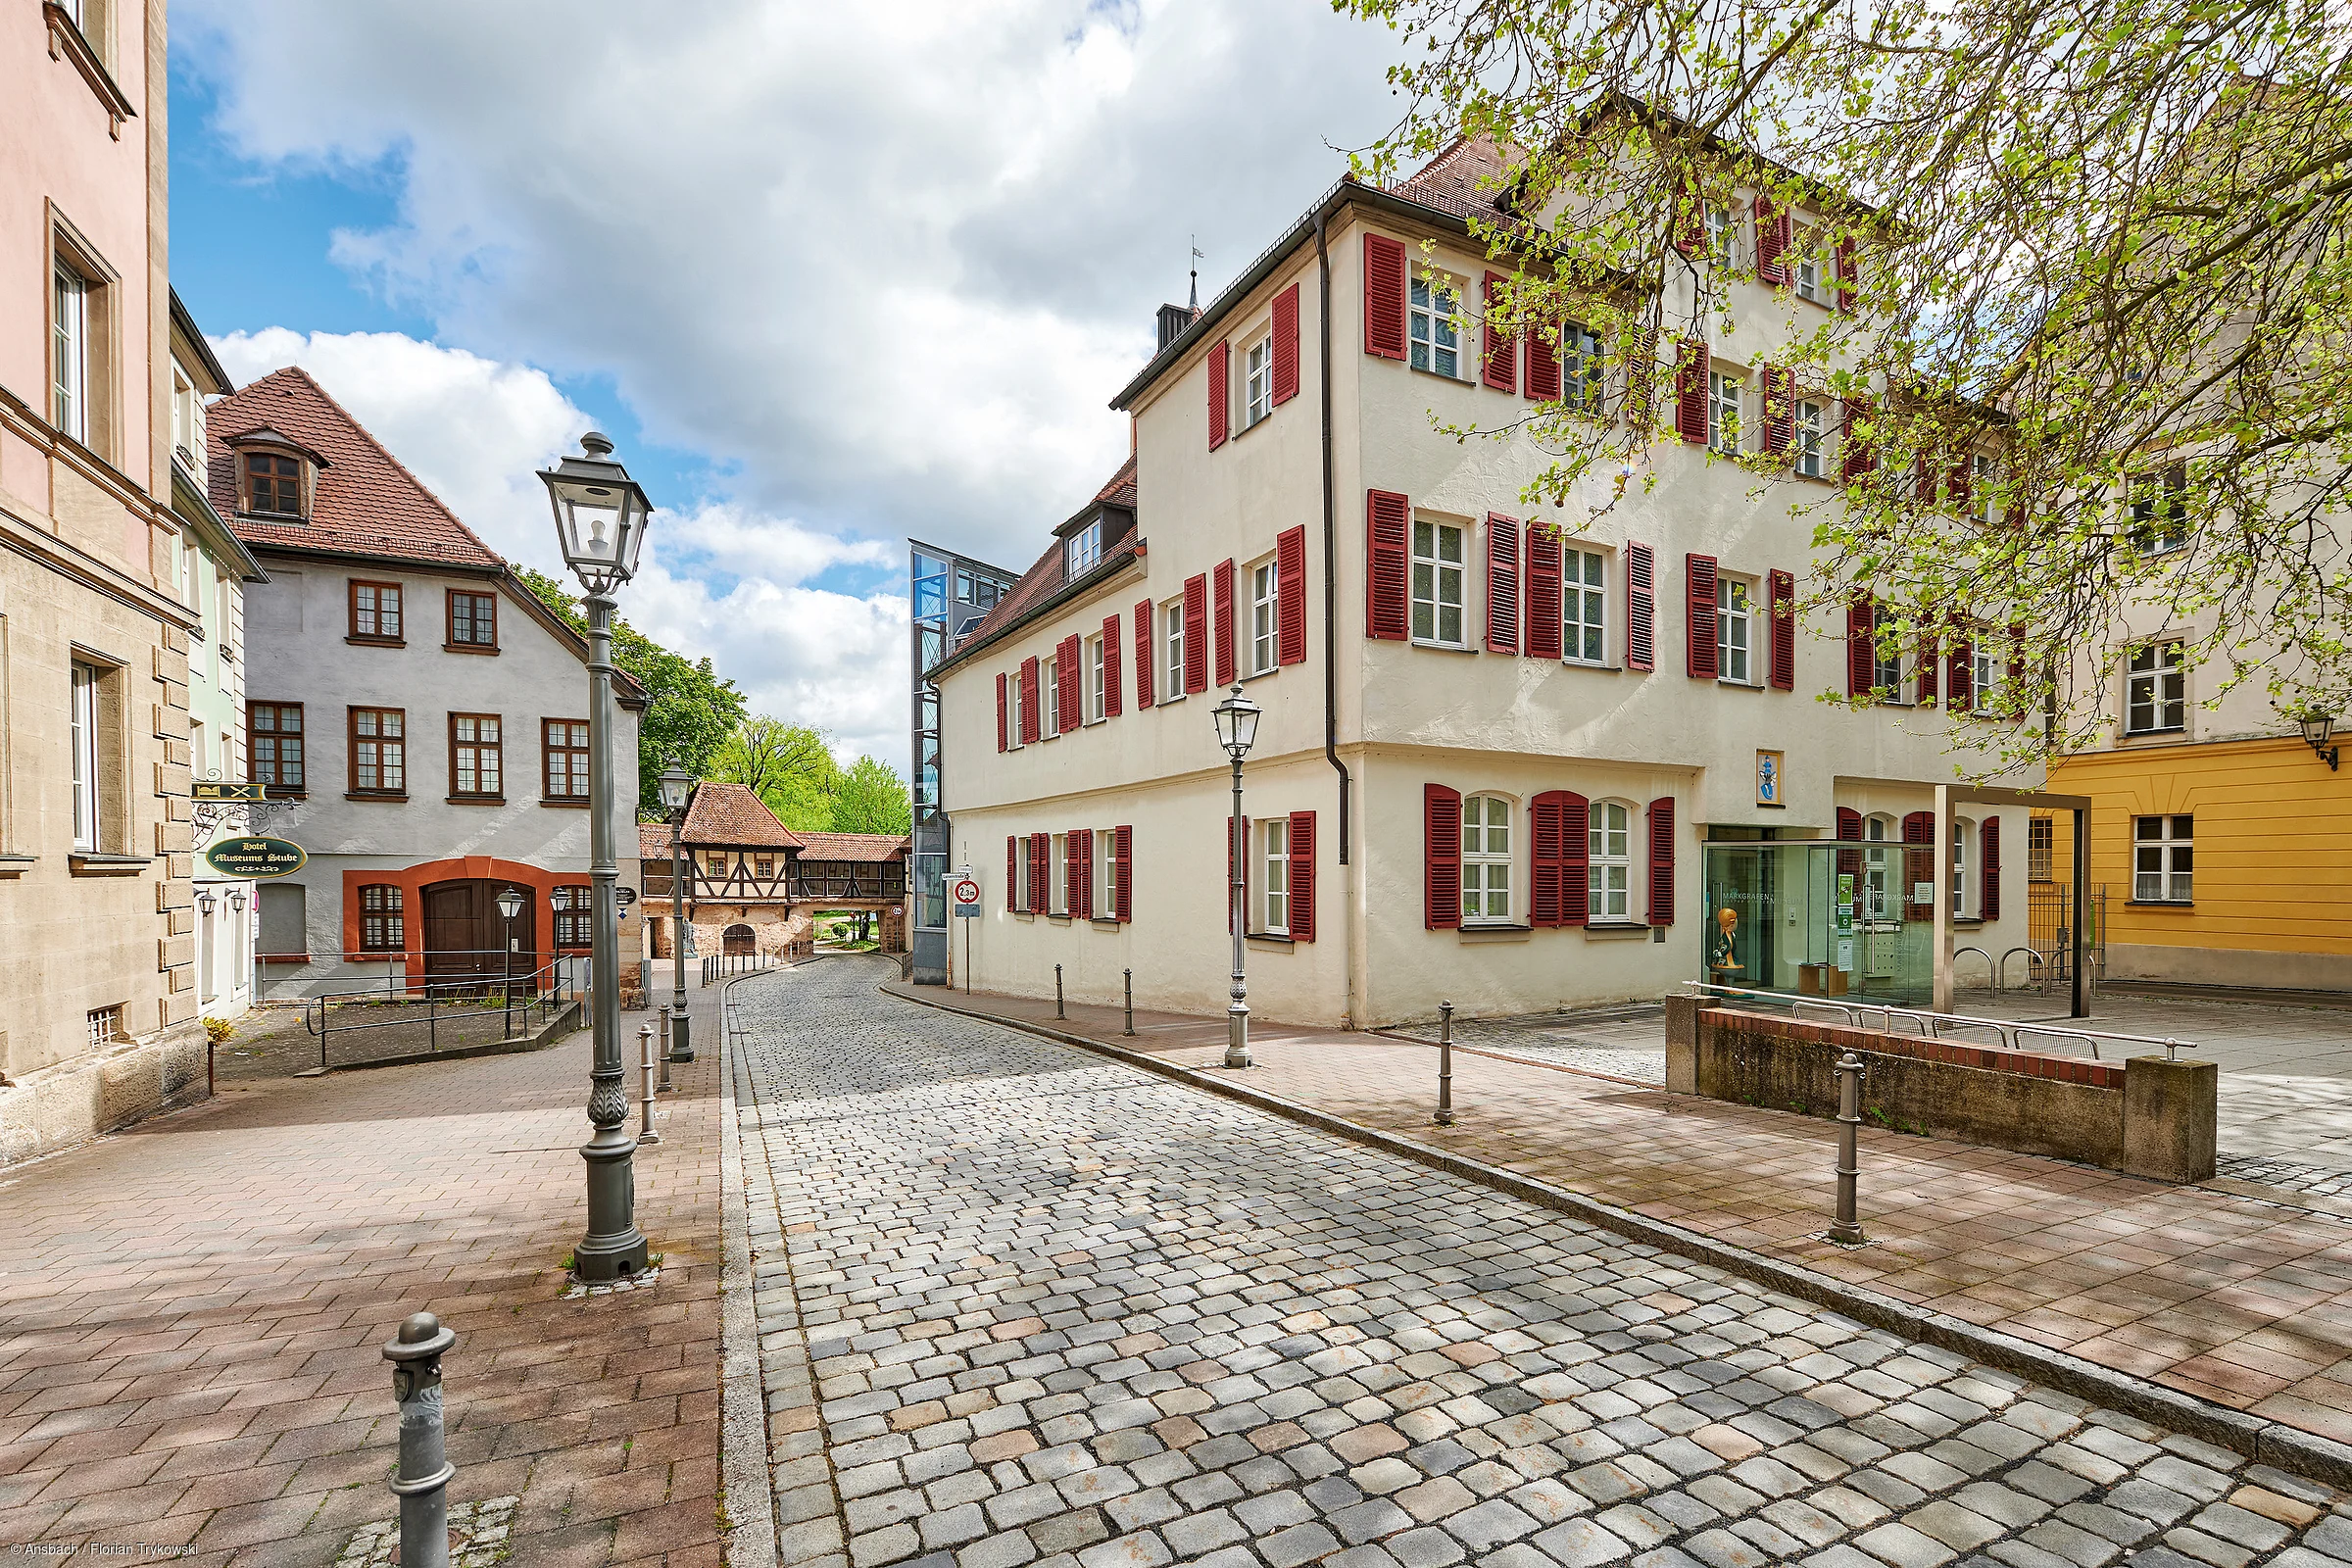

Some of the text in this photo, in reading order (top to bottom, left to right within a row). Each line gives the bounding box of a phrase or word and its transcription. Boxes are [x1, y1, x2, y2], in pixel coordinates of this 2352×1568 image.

[242, 842, 267, 852] Hotel
[214, 853, 298, 862] Museums Stube
